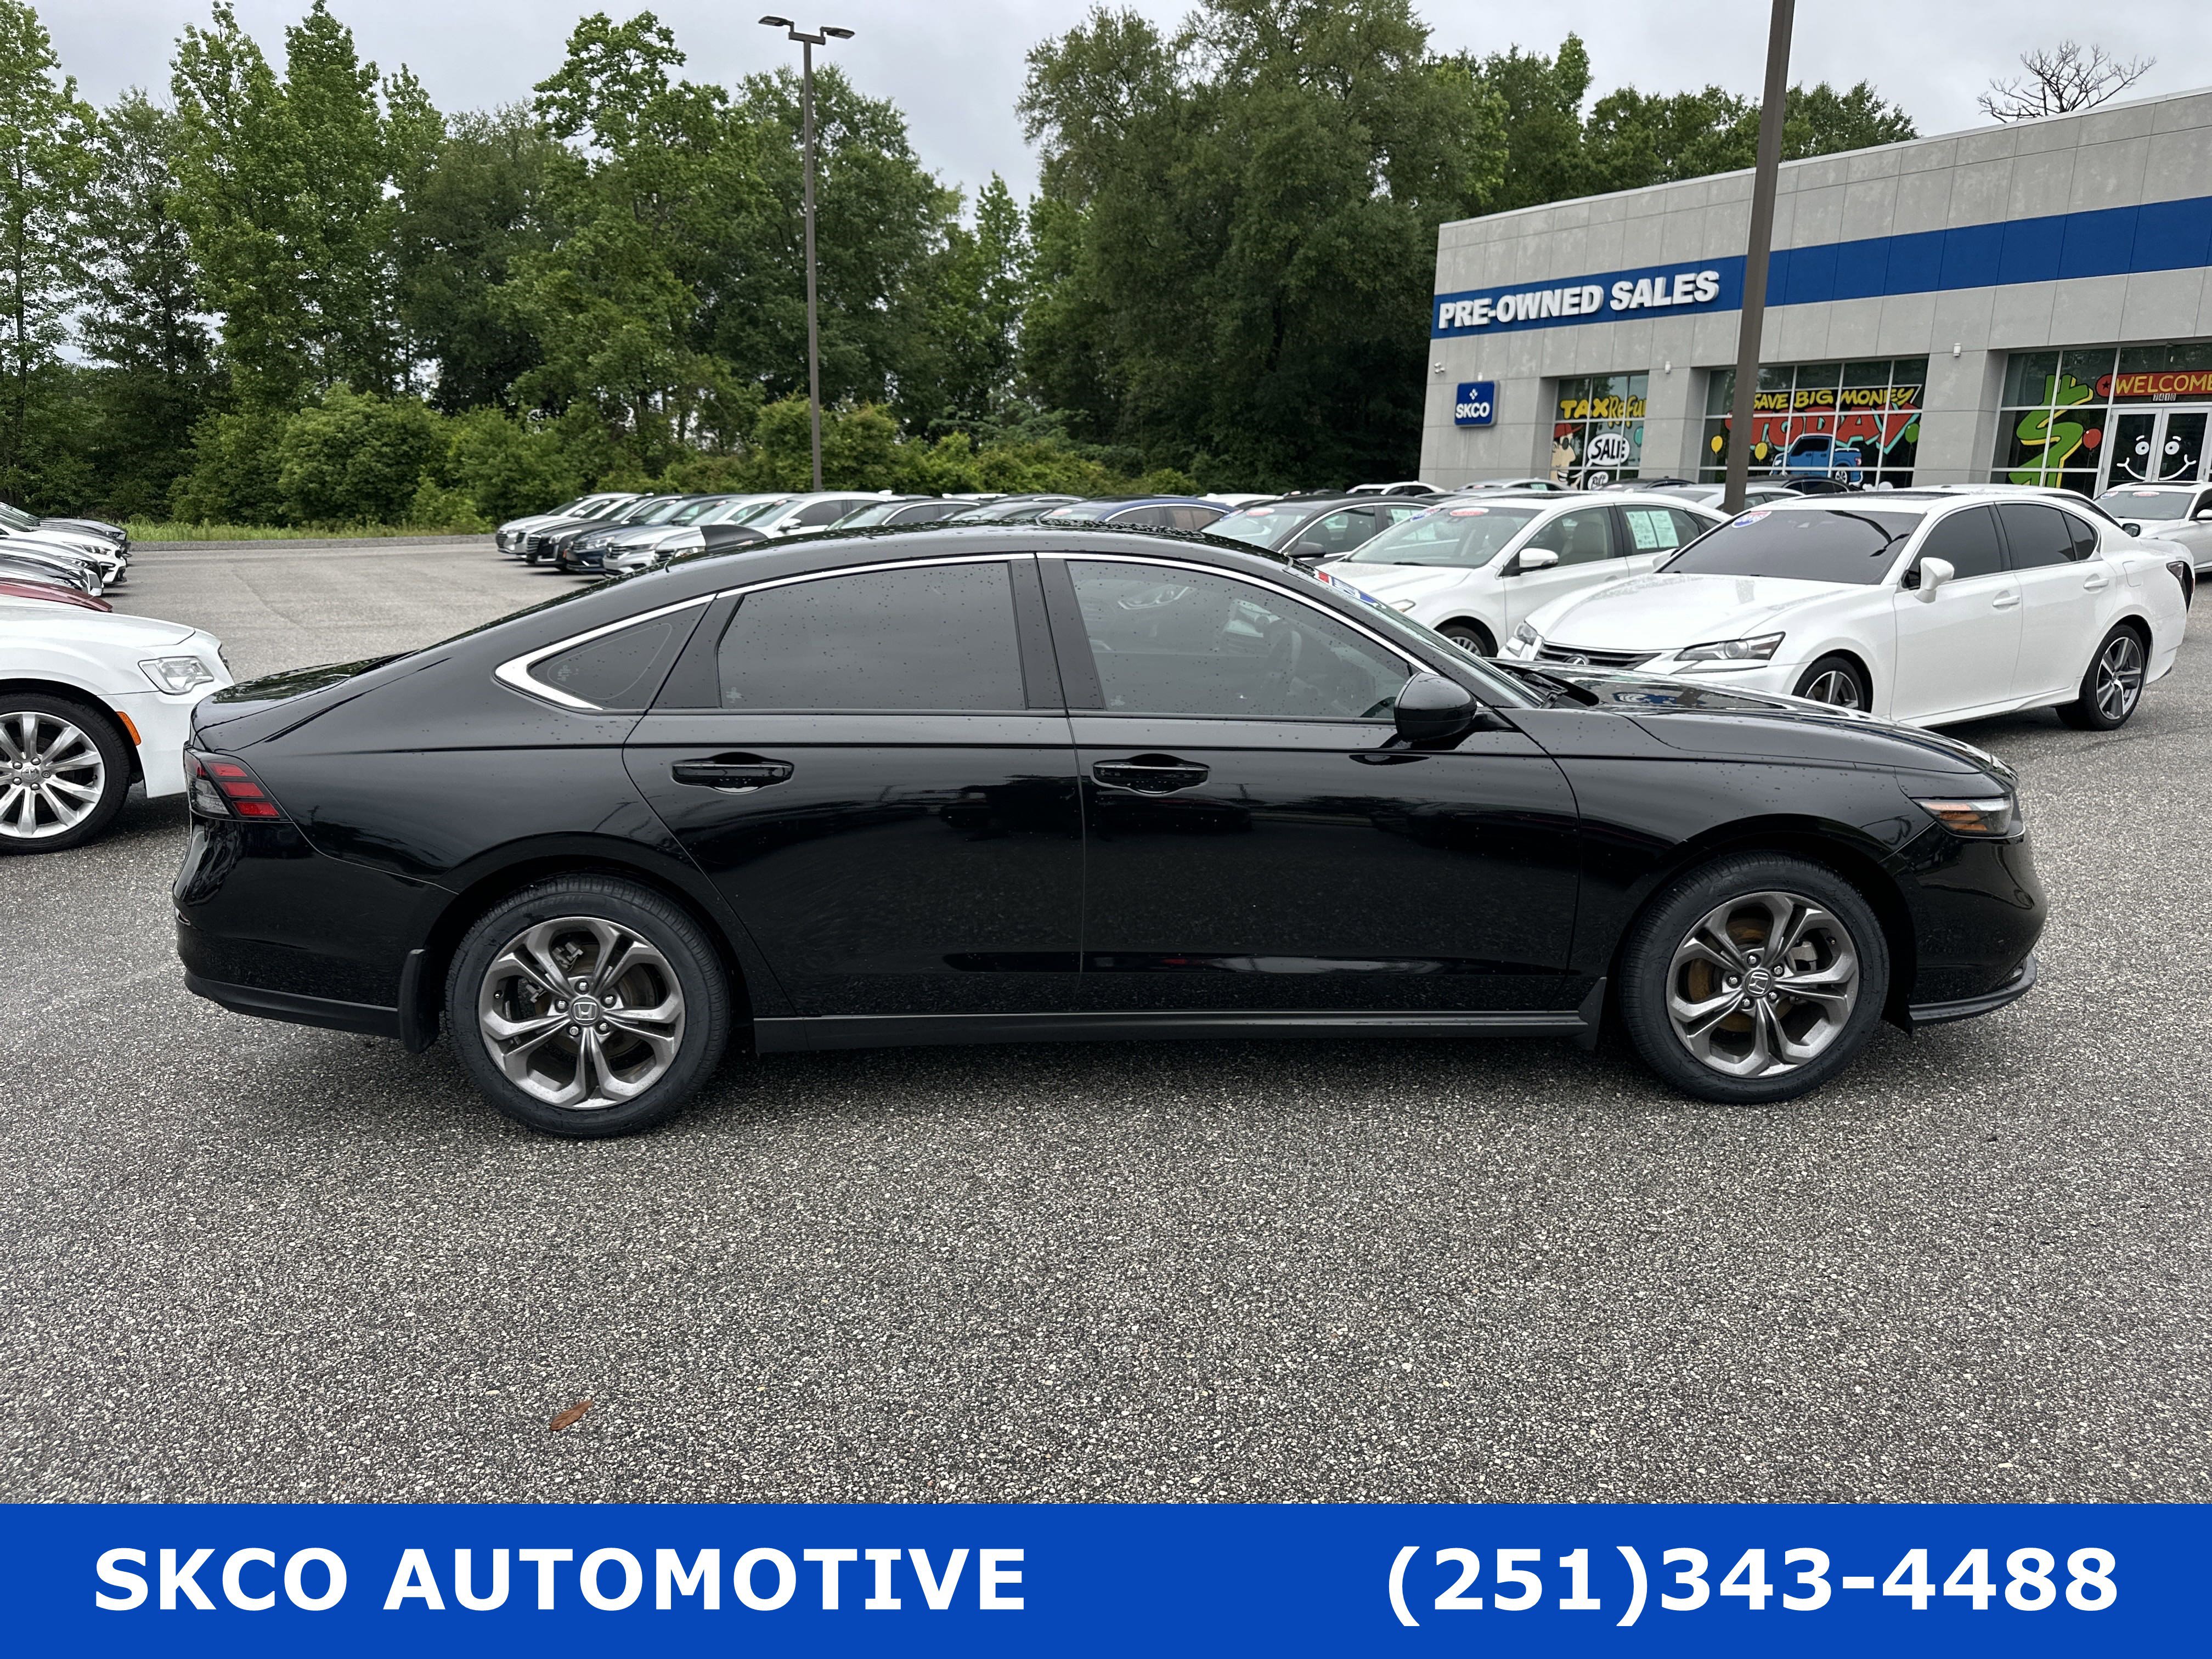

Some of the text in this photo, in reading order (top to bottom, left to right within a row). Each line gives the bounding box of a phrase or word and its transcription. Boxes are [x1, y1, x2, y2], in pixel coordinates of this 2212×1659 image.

[1438, 270, 1719, 329] PRE-OWNED SALES
[1455, 401, 1490, 419] SKCO
[1560, 398, 1609, 419] TAX
[1753, 388, 1915, 410] SAVE BIG MONEY
[1591, 438, 1626, 460] SALE
